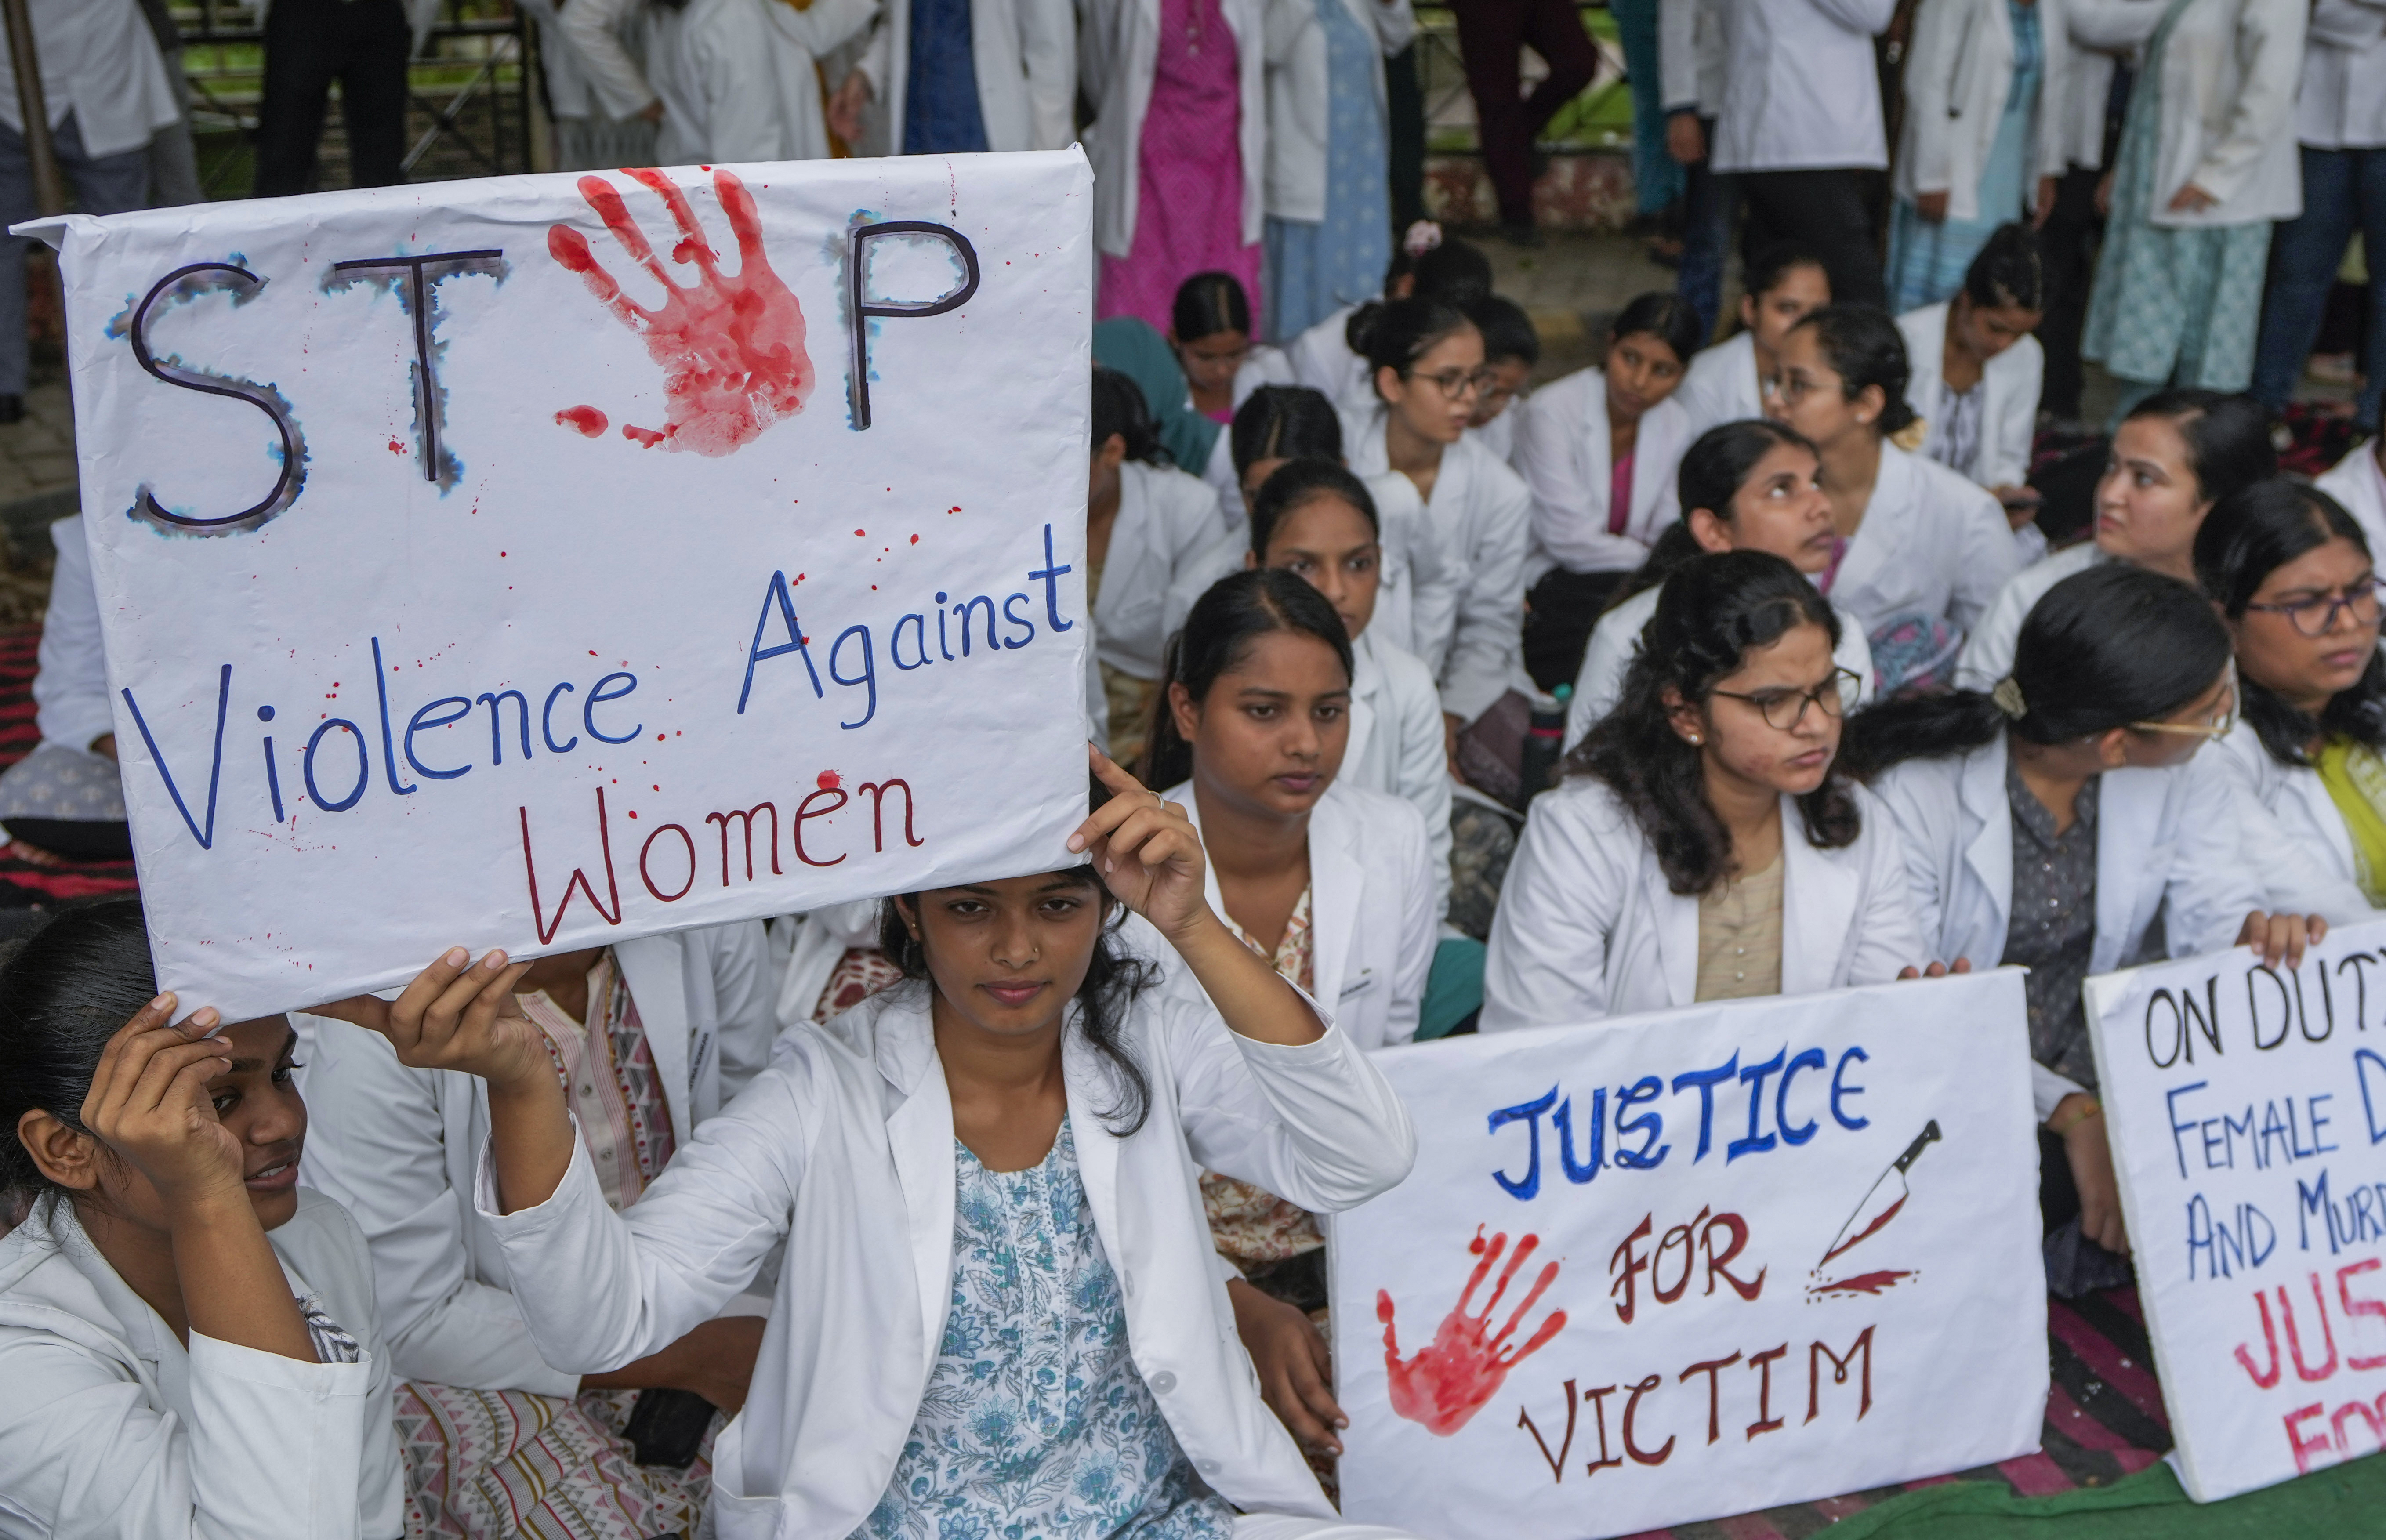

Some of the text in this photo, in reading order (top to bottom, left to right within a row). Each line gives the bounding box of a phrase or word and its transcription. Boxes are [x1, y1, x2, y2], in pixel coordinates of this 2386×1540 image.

[131, 211, 981, 529] STP
[121, 523, 1074, 851] Violence Against
[519, 777, 925, 946] Women
[2145, 946, 2386, 1069] ON DUT
[1487, 1040, 1870, 1202] JUSTICE
[1609, 1204, 1767, 1323] FOR
[2186, 1192, 2277, 1280] AND
[1517, 1325, 1877, 1484] VICTIM
